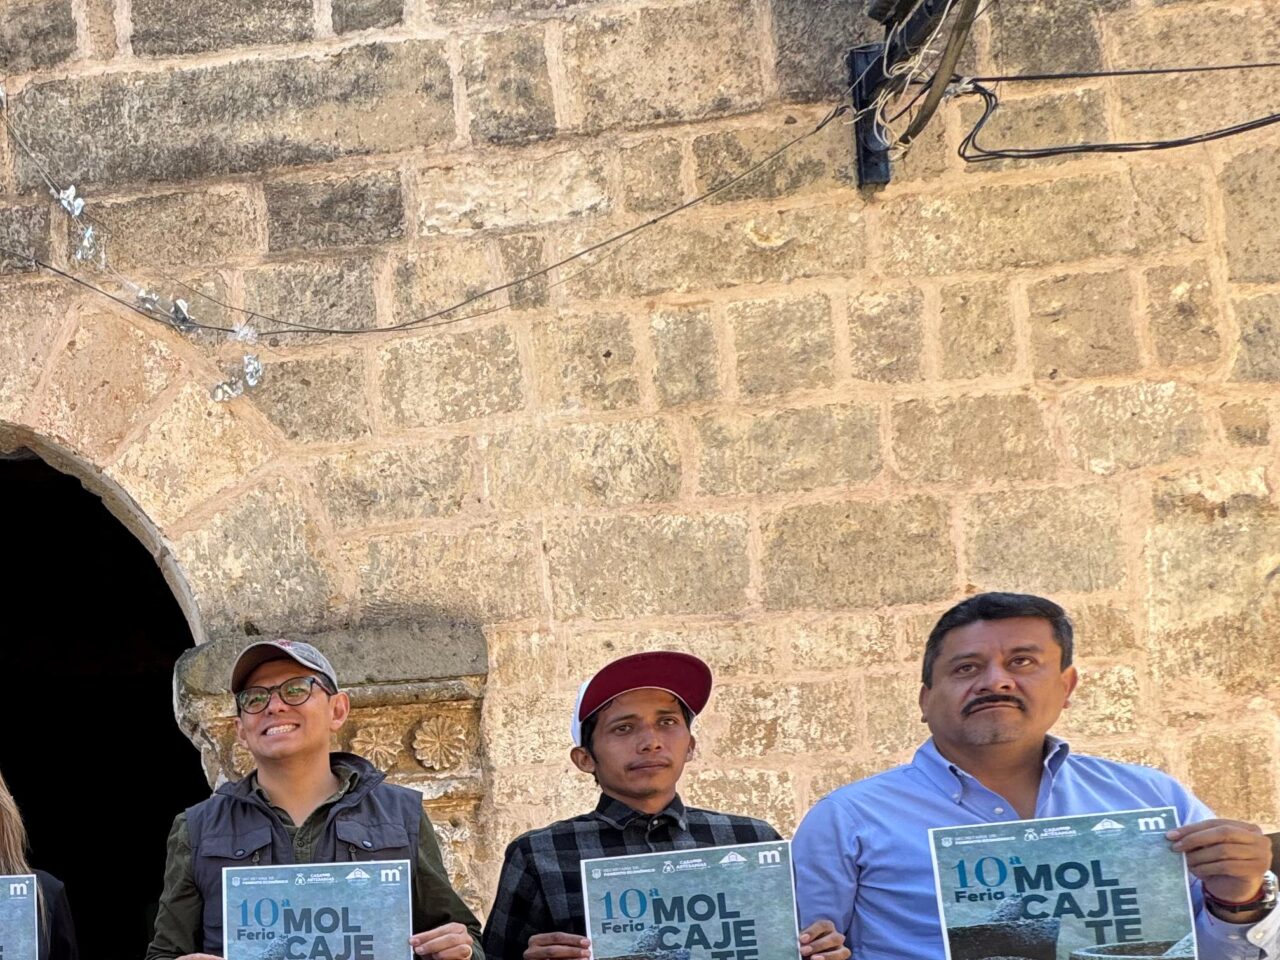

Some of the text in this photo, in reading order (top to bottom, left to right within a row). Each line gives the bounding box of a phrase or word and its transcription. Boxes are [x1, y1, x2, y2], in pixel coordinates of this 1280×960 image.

[1138, 816, 1165, 832] m
[759, 851, 780, 864] m
[381, 869, 400, 882] m
[1012, 860, 1118, 893] MOL
[10, 884, 27, 896] m
[955, 890, 1005, 903] Feria
[652, 892, 740, 924] MOL
[1021, 887, 1140, 920] CAJE
[283, 907, 361, 934] MOL
[602, 920, 644, 934] Feria
[237, 929, 275, 940] Feria
[659, 920, 757, 950] CAJE
[1085, 917, 1143, 945] TE
[286, 935, 374, 960] CAJE
